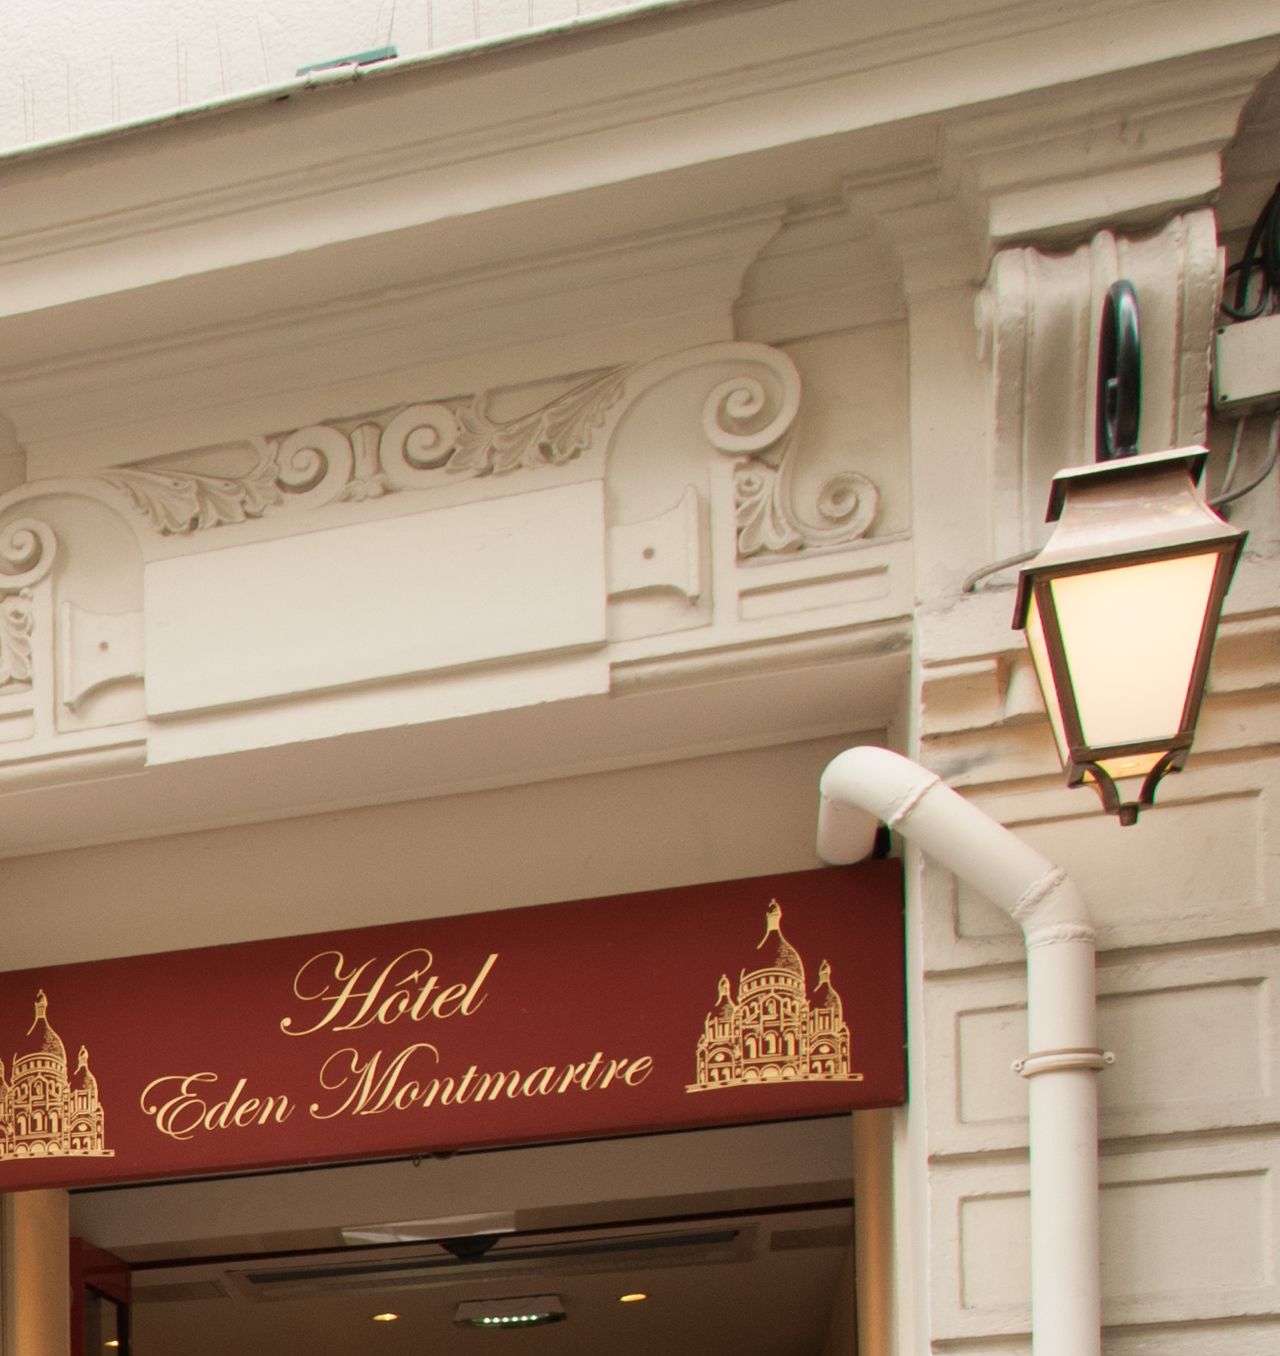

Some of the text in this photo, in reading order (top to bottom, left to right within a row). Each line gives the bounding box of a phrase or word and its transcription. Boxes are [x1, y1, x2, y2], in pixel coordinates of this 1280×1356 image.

[280, 948, 499, 1036] Hôtel
[141, 1043, 654, 1140] Eden Montmartre
